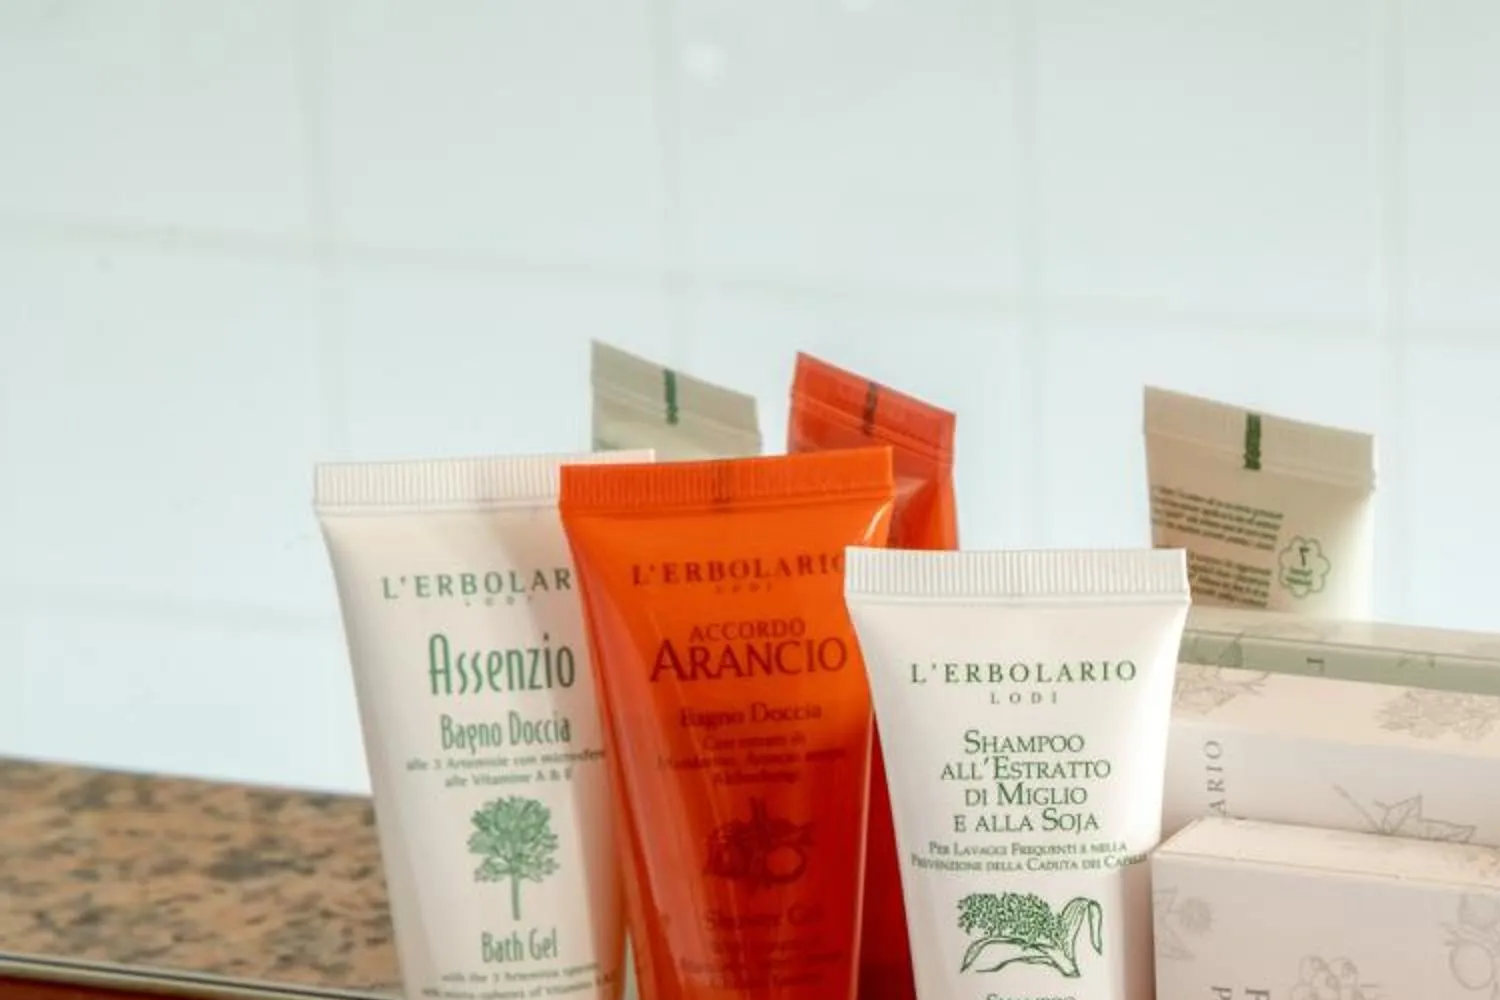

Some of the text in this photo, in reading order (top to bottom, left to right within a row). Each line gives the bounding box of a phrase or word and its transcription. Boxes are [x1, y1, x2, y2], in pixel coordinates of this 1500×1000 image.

[381, 567, 573, 600] L'ERBOLAR
[631, 553, 846, 586] L'ERBOLARIO
[689, 617, 806, 642] ACCORDO
[428, 632, 576, 696] Assenzio
[650, 636, 849, 683] ARANCIO
[910, 660, 1137, 683] L'ERBOLARIO
[750, 701, 823, 723] Doccia
[990, 691, 1058, 705] LODI
[440, 710, 571, 754] Bagno Doccia
[963, 729, 1085, 755] SHAMPOO
[964, 781, 1088, 807] DI MIGLIO
[953, 807, 1100, 835] E ALLA SOJA
[481, 927, 558, 963] Bath Gel
